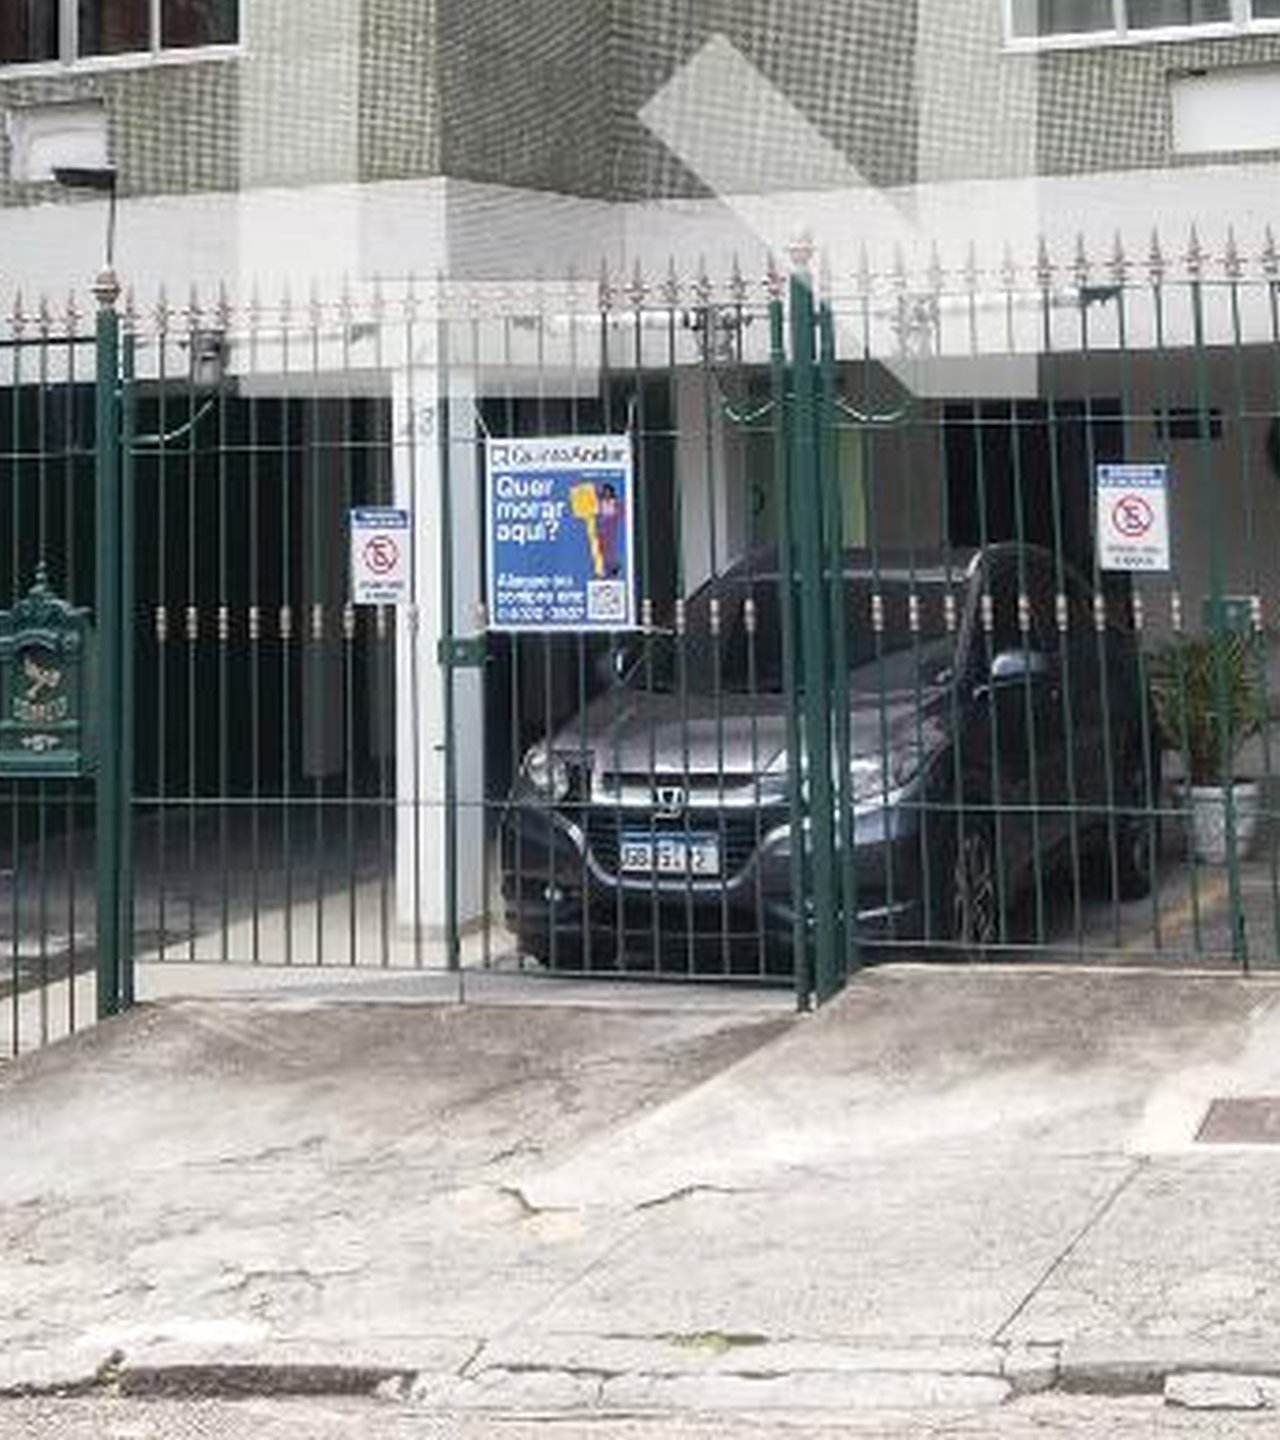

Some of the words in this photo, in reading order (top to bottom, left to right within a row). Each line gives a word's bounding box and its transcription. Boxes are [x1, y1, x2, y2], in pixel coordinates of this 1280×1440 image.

[497, 476, 555, 499] Quer
[497, 499, 567, 520] morar
[497, 519, 561, 546] aqui?
